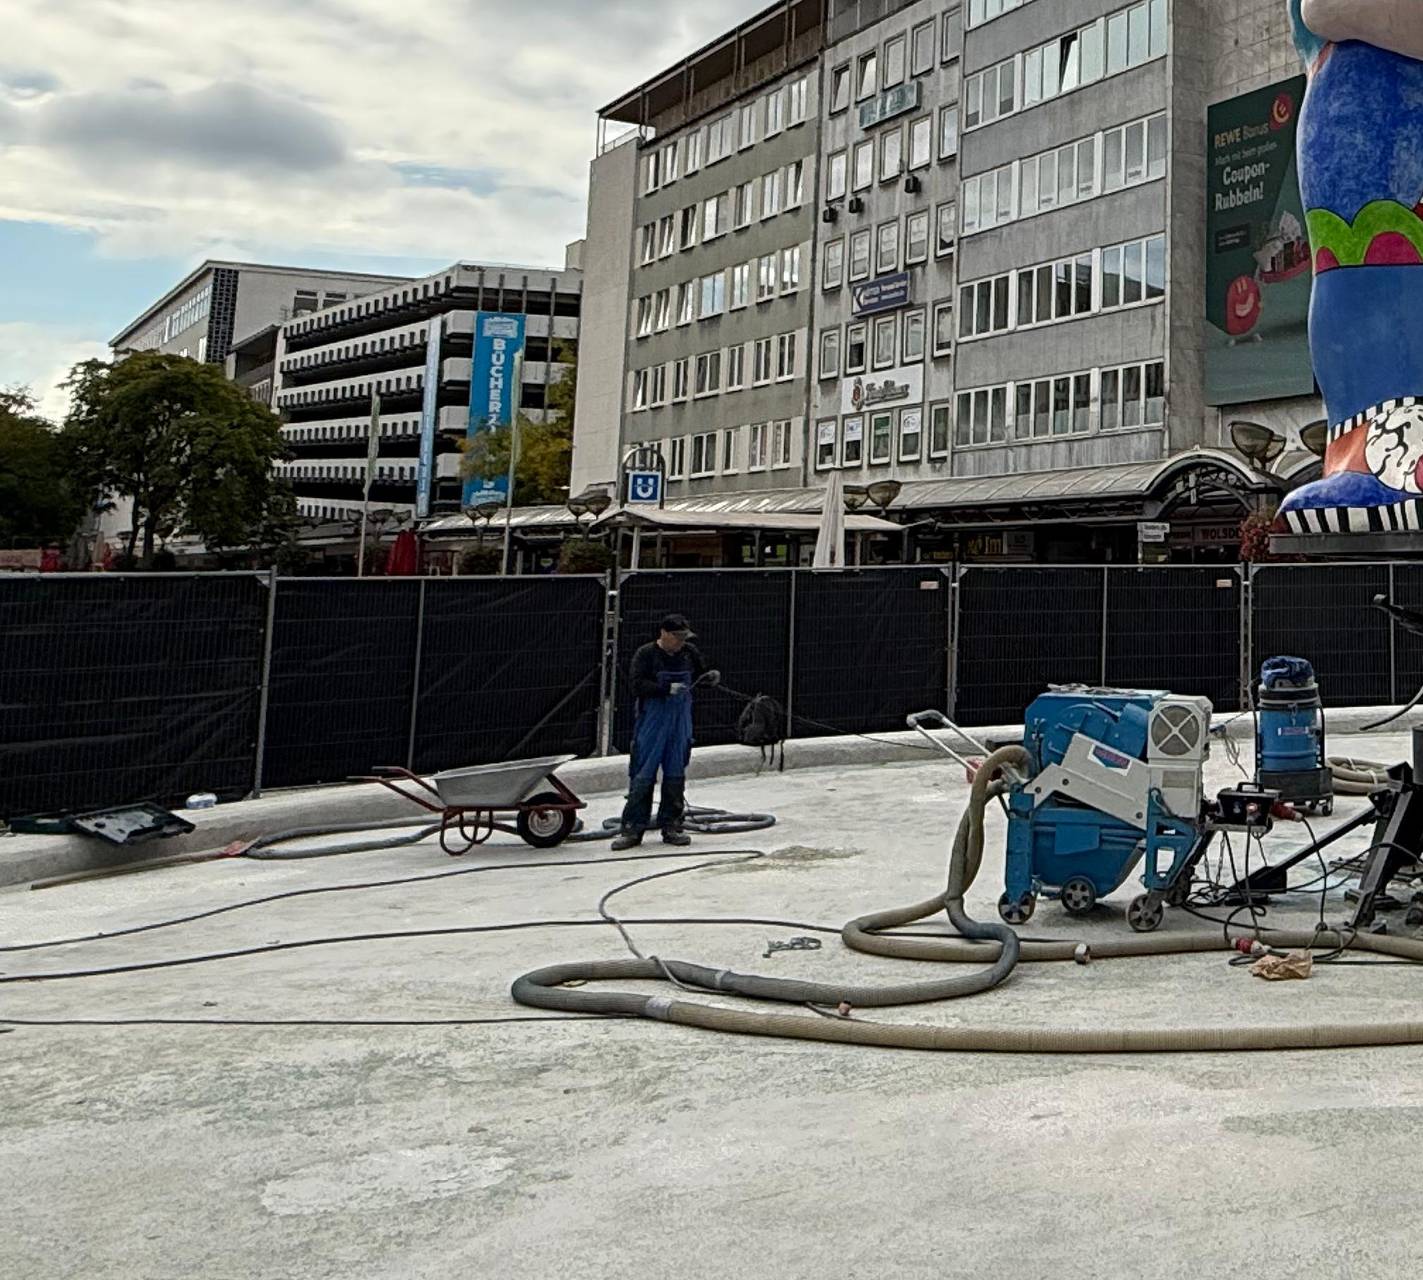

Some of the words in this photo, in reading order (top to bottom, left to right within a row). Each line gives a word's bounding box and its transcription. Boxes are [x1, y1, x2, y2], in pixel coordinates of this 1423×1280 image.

[1214, 128, 1241, 149] REWE
[1223, 162, 1271, 186] Coupon-
[1214, 181, 1264, 212] Rubbeln!
